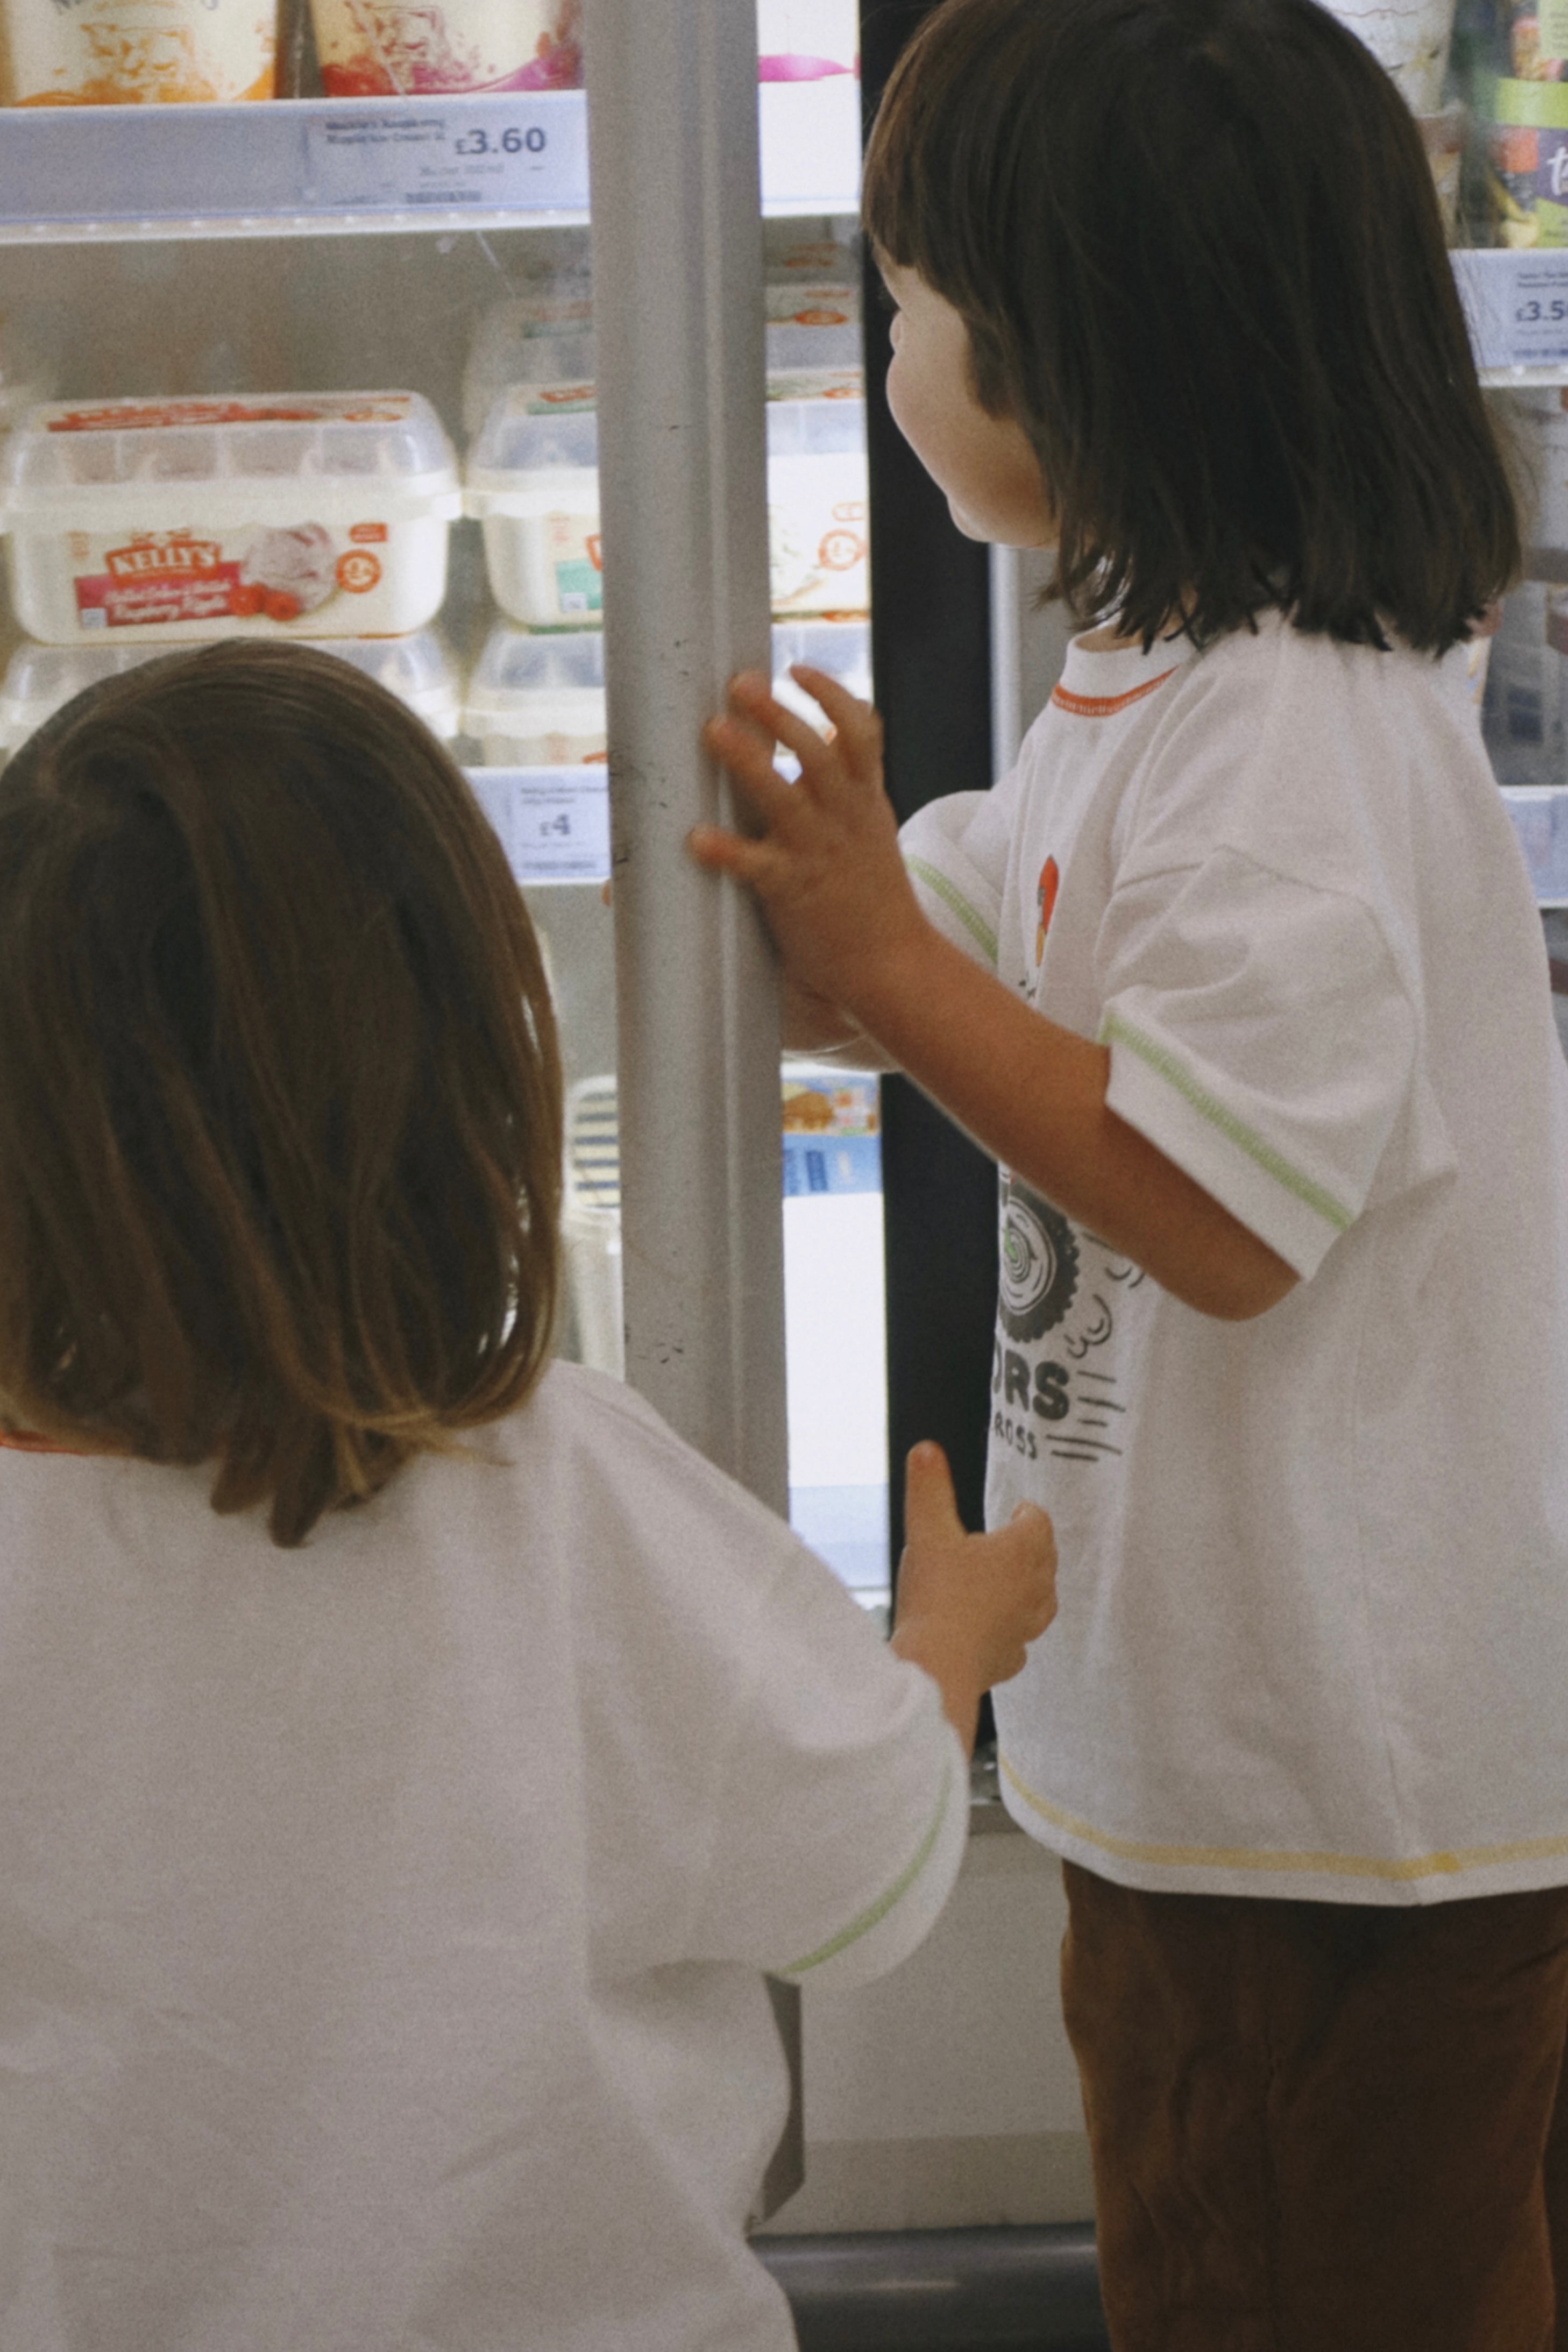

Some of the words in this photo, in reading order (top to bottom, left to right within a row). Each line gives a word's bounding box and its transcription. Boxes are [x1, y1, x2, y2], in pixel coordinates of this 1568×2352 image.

[455, 126, 546, 155] £3.60
[1515, 300, 1568, 321] £3.5
[112, 545, 216, 575] KELLY'S
[540, 813, 570, 835] £4
